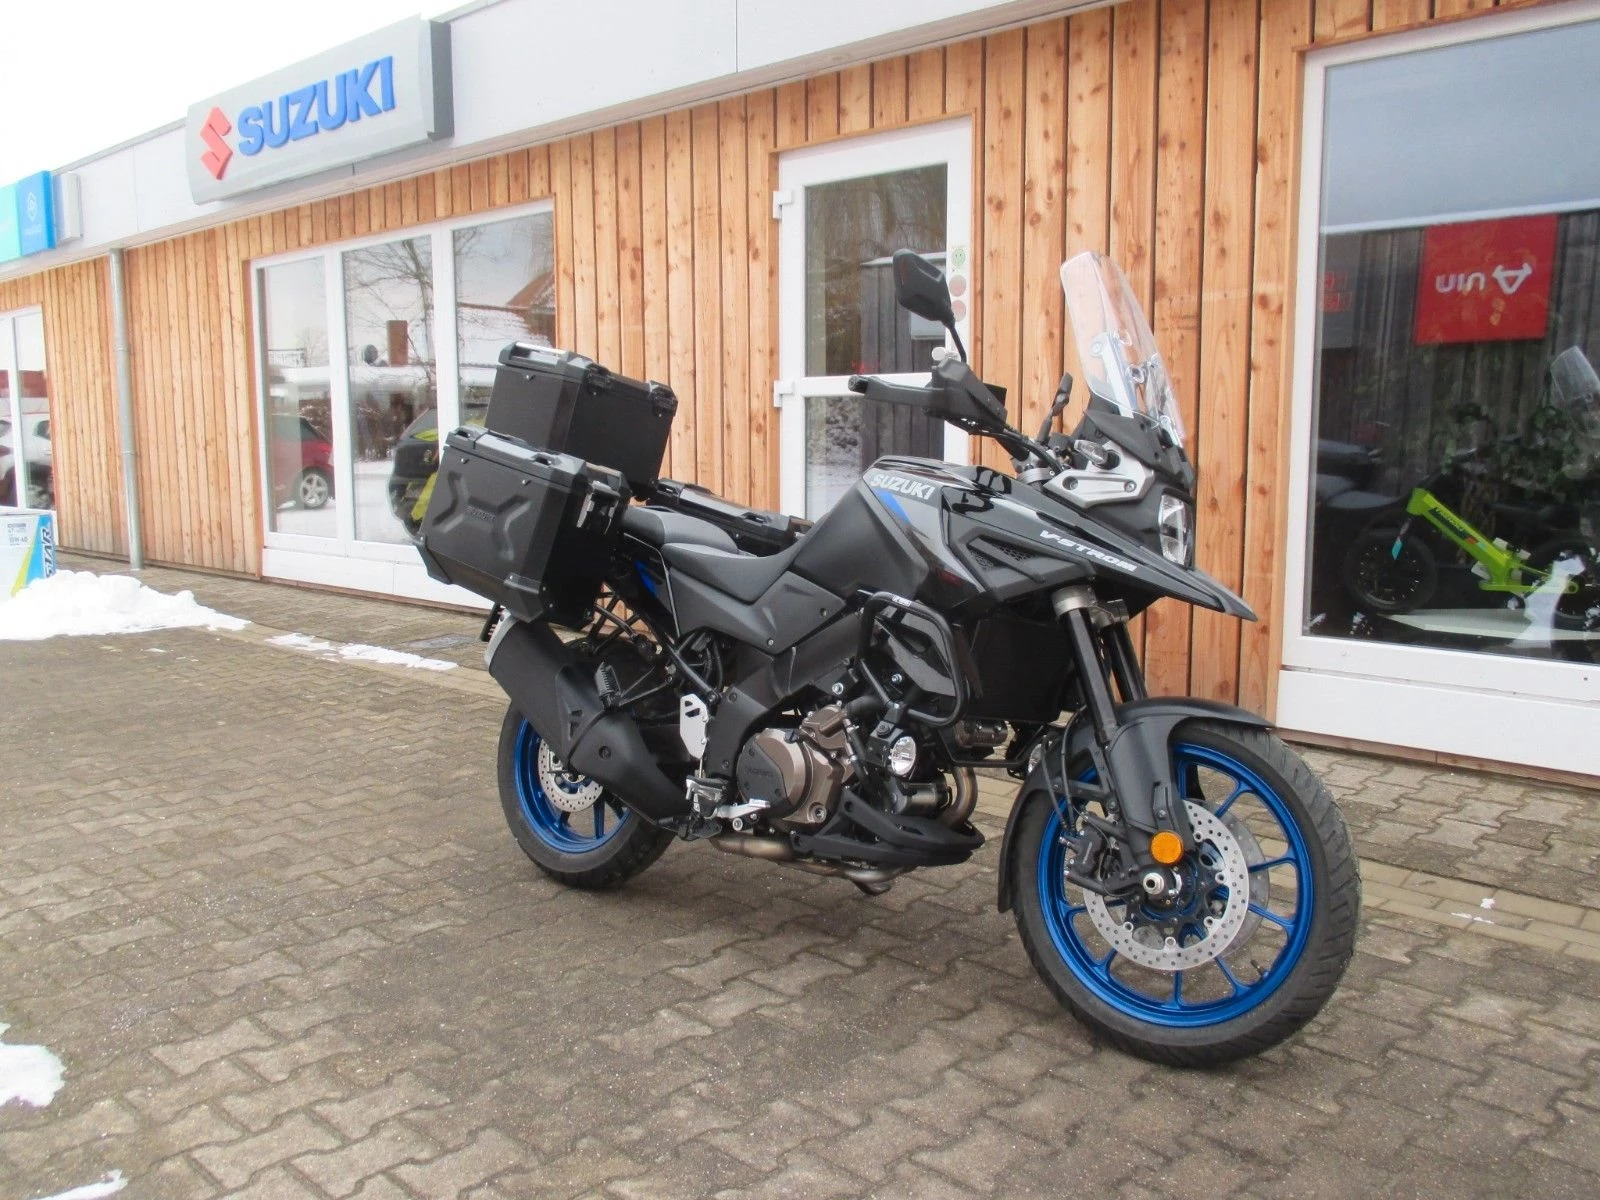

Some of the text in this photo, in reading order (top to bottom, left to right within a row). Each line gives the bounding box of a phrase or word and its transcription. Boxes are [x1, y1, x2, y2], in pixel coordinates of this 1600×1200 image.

[237, 56, 396, 157] SUZUKI
[870, 474, 936, 500] SUZUKI
[1040, 530, 1138, 572] V-STROM
